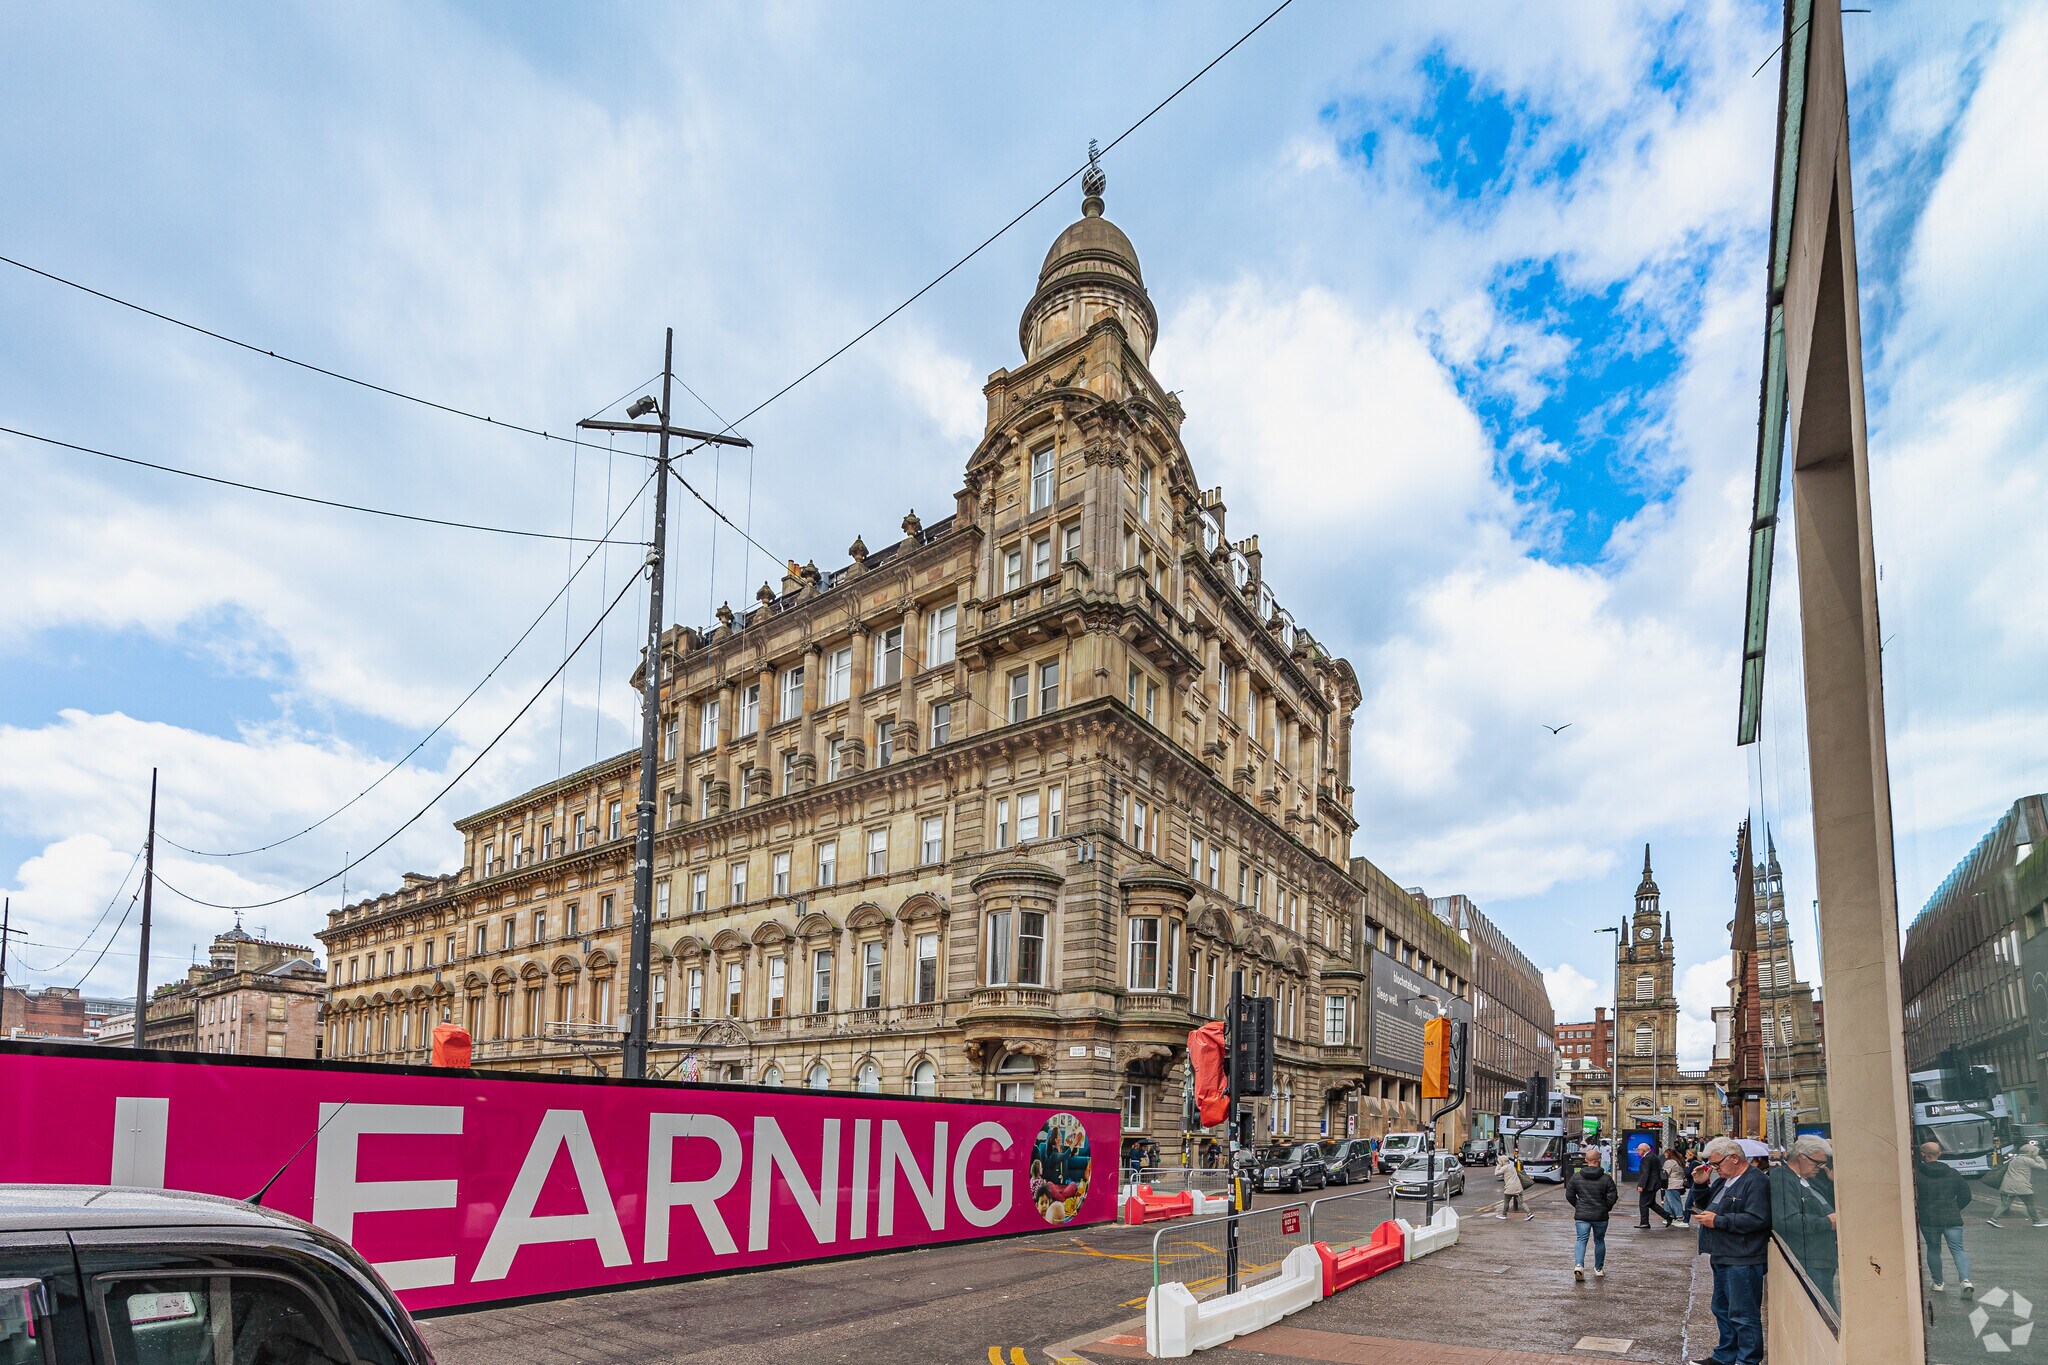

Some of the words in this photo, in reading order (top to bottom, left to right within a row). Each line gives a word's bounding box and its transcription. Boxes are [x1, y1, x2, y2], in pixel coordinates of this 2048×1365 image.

[1376, 986, 1389, 1004] Sleep
[1414, 1004, 1423, 1019] Stay
[1543, 1121, 1550, 1129] 41
